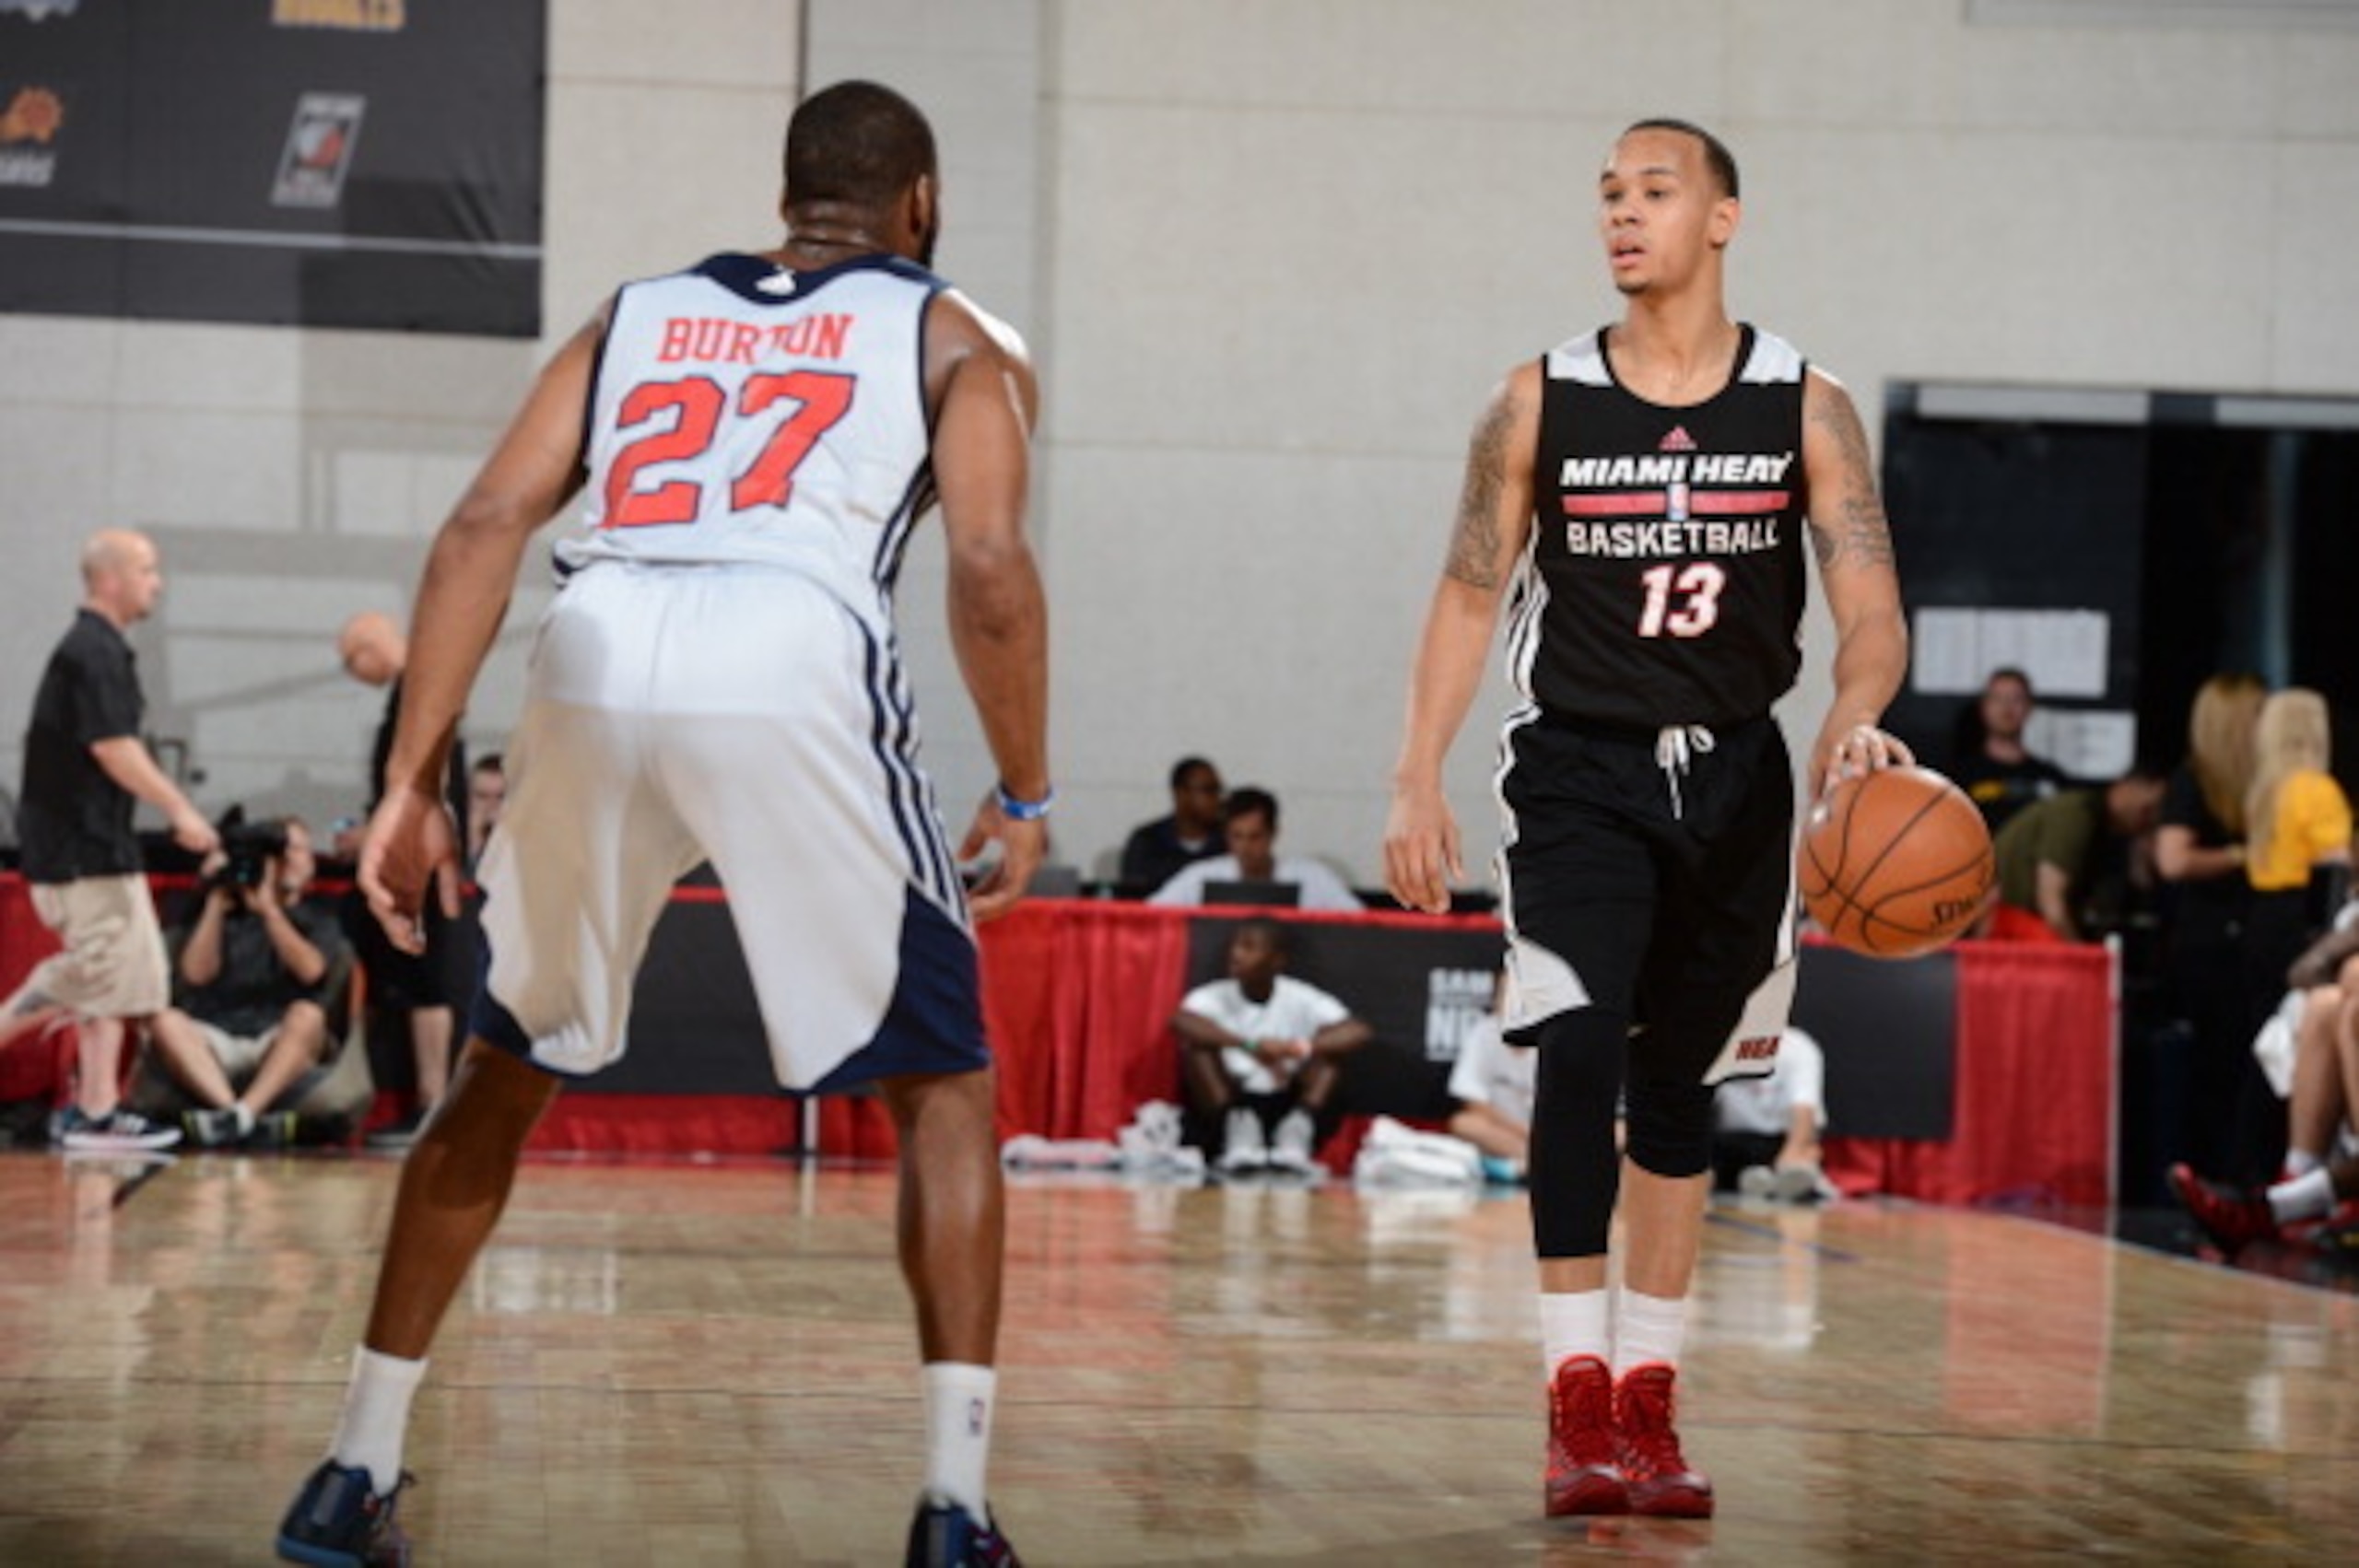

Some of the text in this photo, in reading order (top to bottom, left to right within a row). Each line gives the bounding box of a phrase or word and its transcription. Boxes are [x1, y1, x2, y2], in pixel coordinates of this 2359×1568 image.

[657, 313, 854, 364] BURTON
[599, 369, 857, 530] 27
[1560, 451, 1793, 486] MIAMI HEAT
[1567, 519, 1779, 557] BASKETBALL
[1638, 563, 1725, 638] 13
